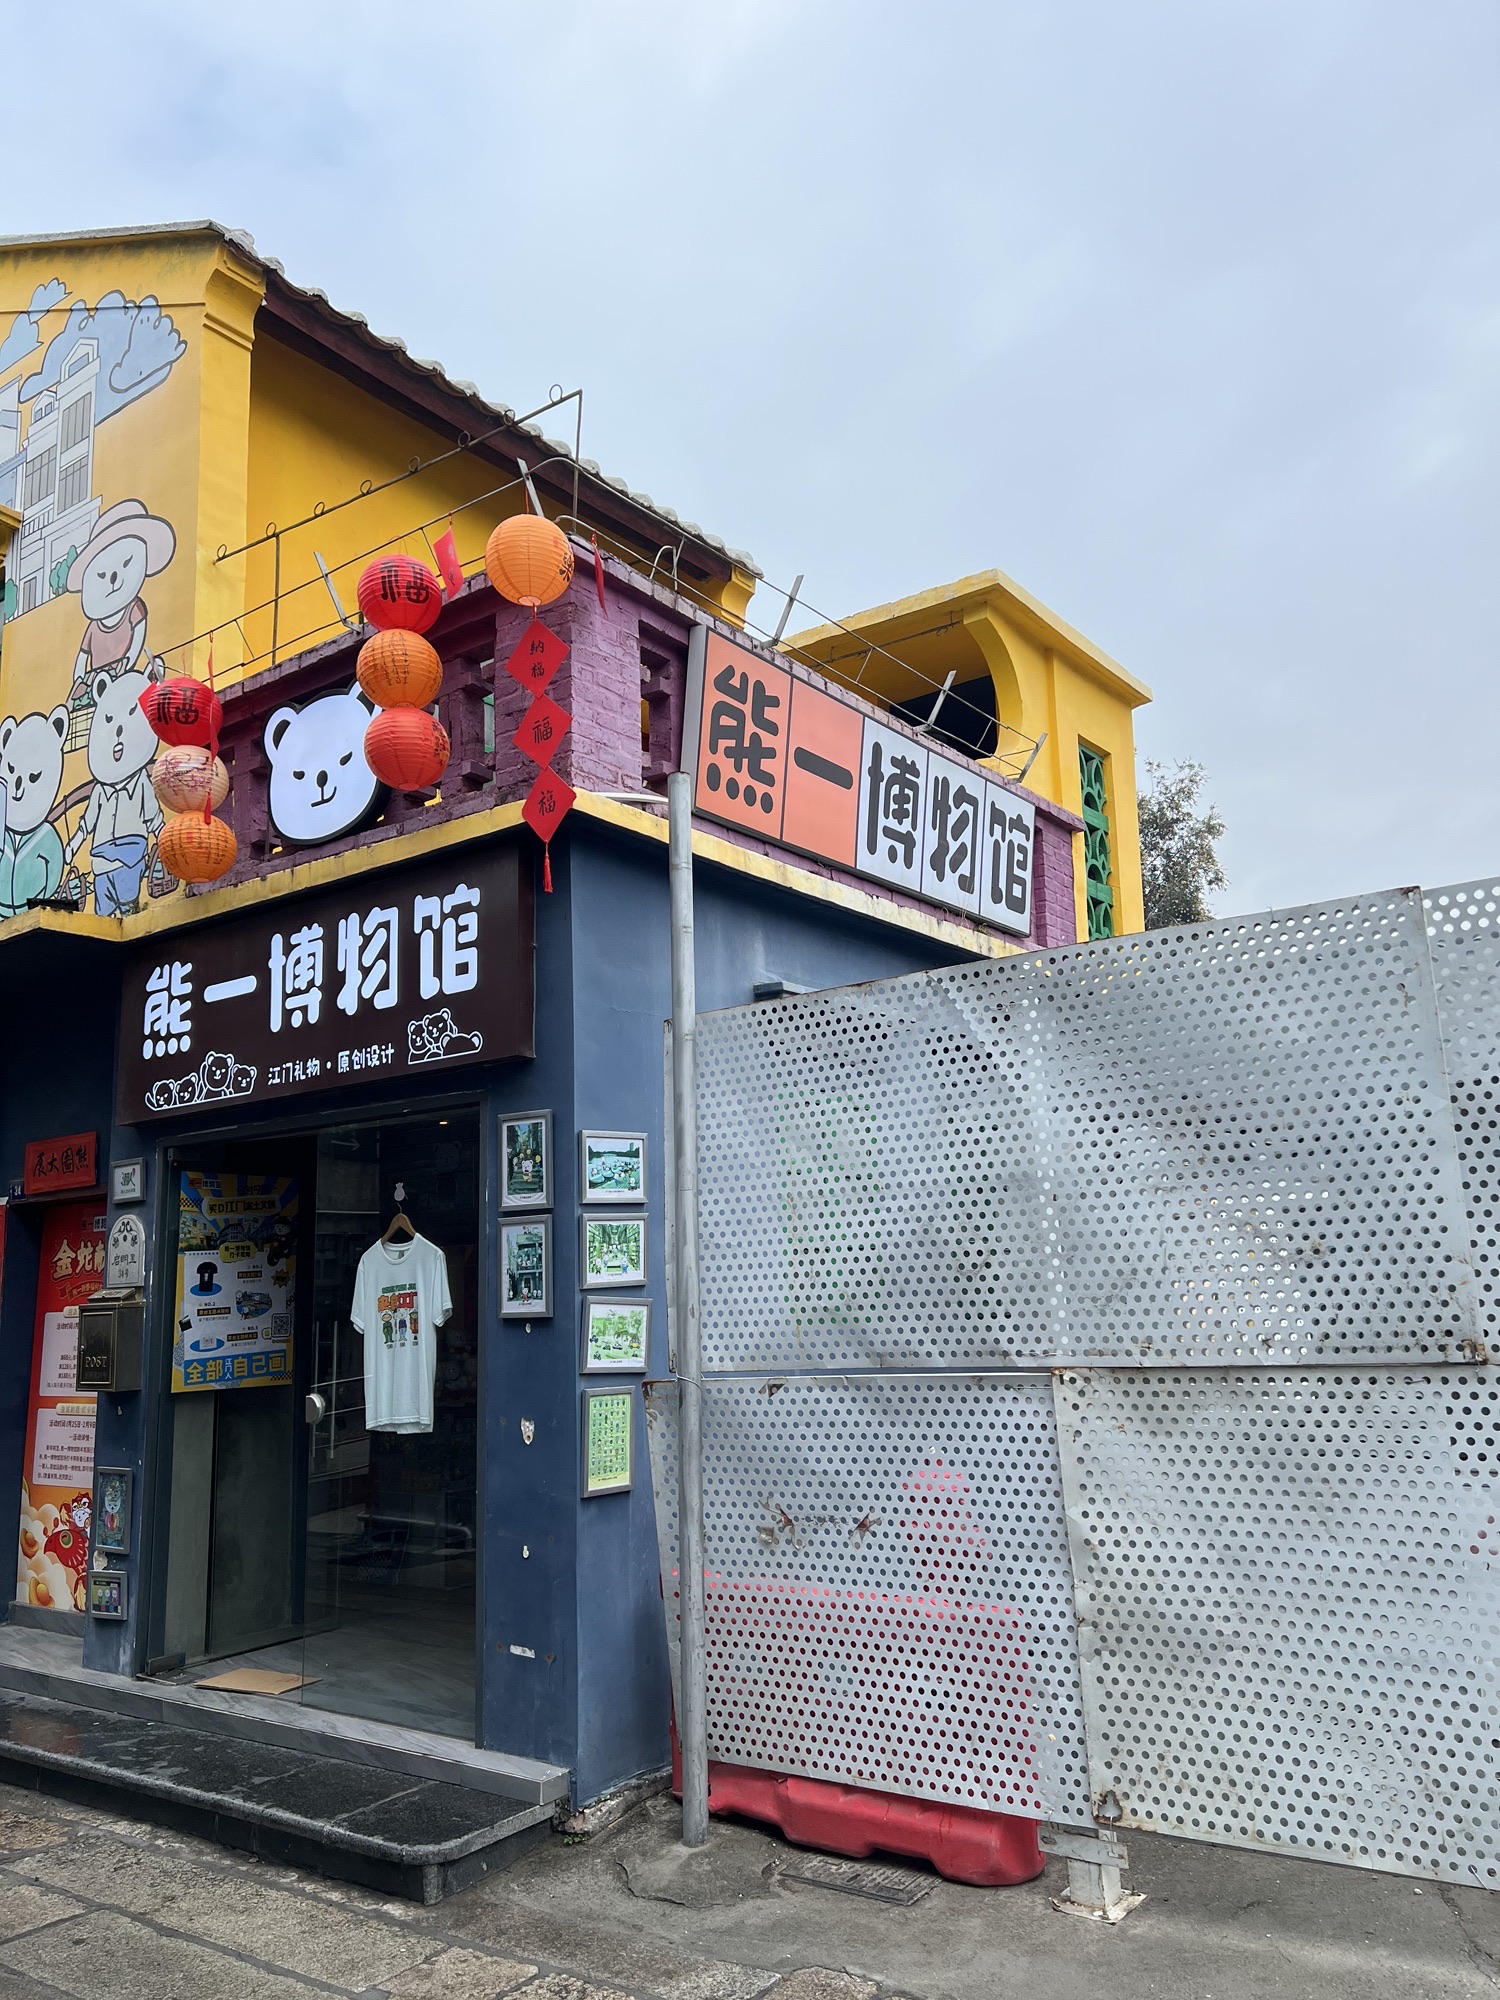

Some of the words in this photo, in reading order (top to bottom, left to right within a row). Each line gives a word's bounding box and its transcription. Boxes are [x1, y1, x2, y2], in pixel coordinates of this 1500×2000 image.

[380, 560, 431, 604] 福
[157, 686, 199, 725] 福
[531, 716, 553, 744] 福
[536, 790, 556, 816] 福
[707, 665, 1030, 914] 熊一博物馆
[143, 883, 480, 1060] 熊一博物馆
[85, 1356, 107, 1368] POST
